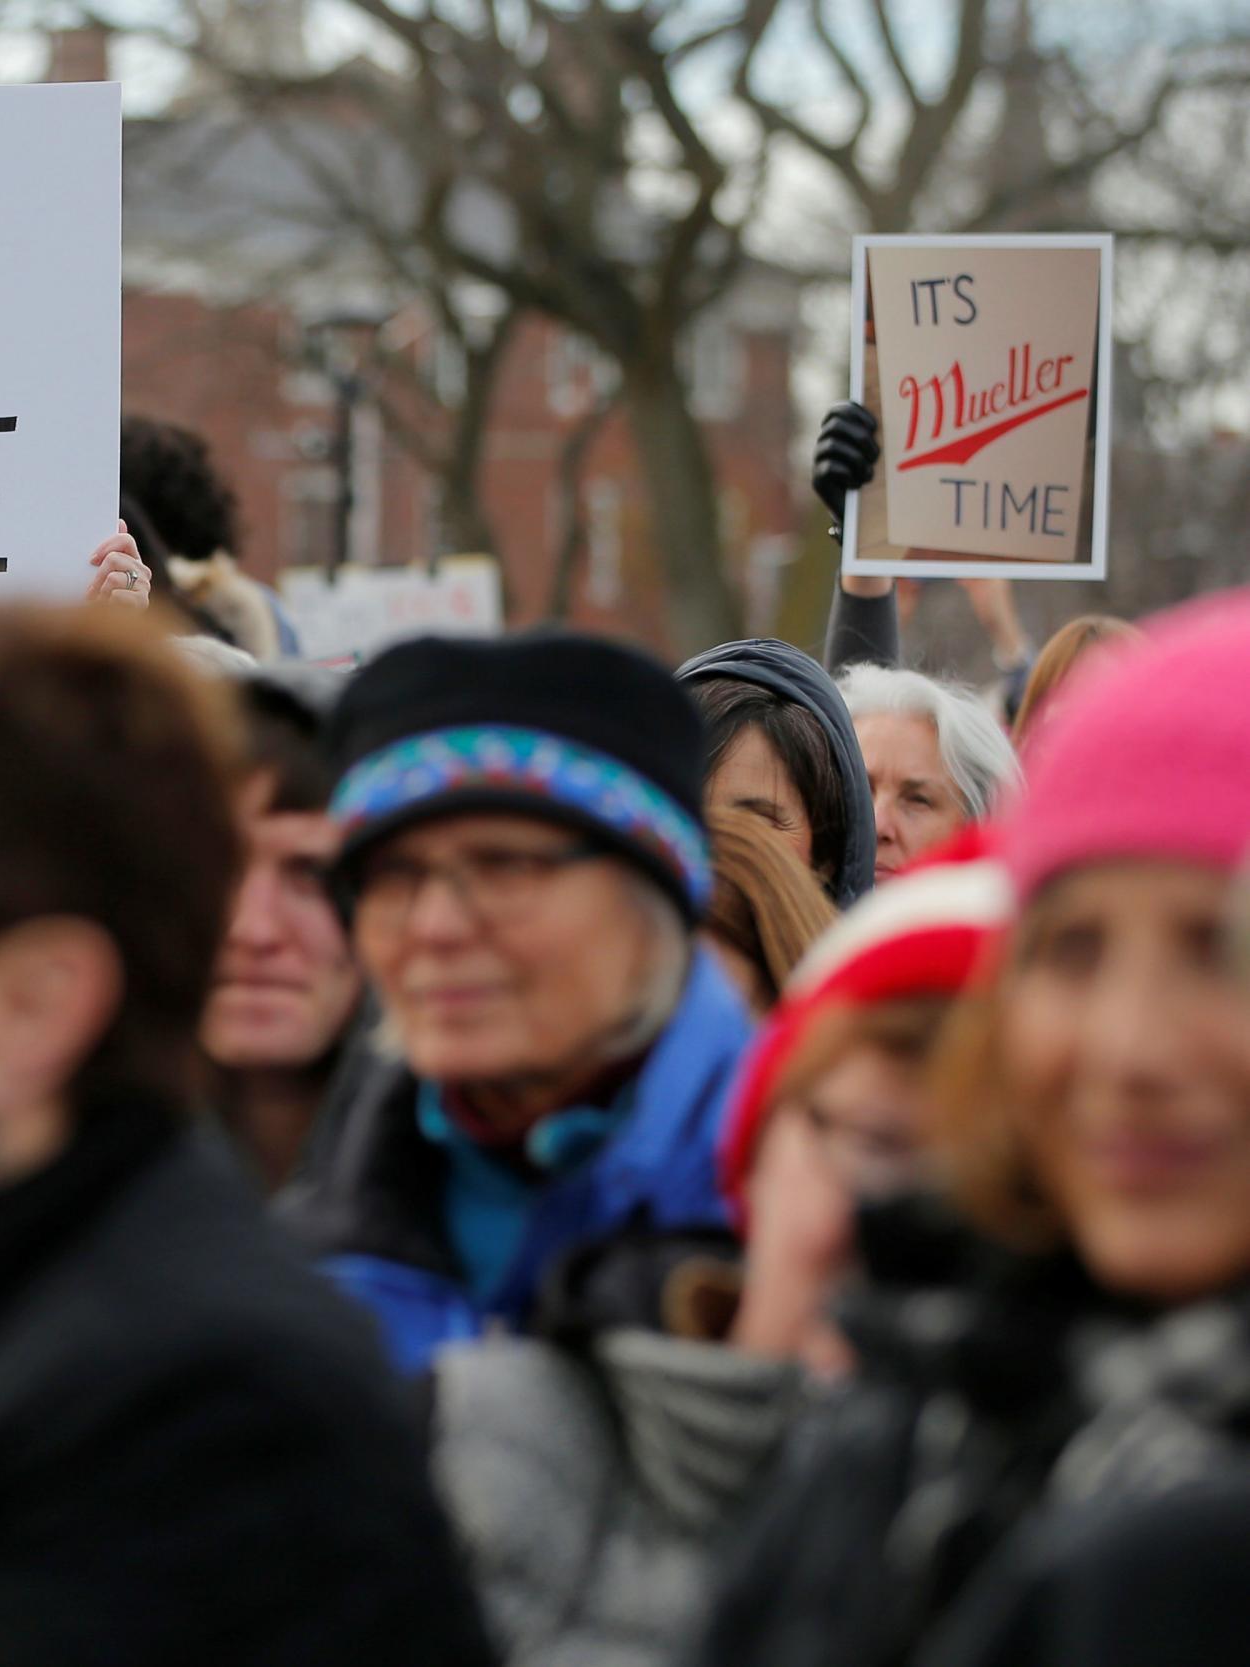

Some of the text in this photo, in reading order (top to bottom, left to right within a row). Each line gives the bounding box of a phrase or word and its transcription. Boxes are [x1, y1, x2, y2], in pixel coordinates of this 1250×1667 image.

[910, 273, 979, 327] IT'S
[898, 342, 1074, 452] Mueller
[939, 477, 1070, 538] TIME
